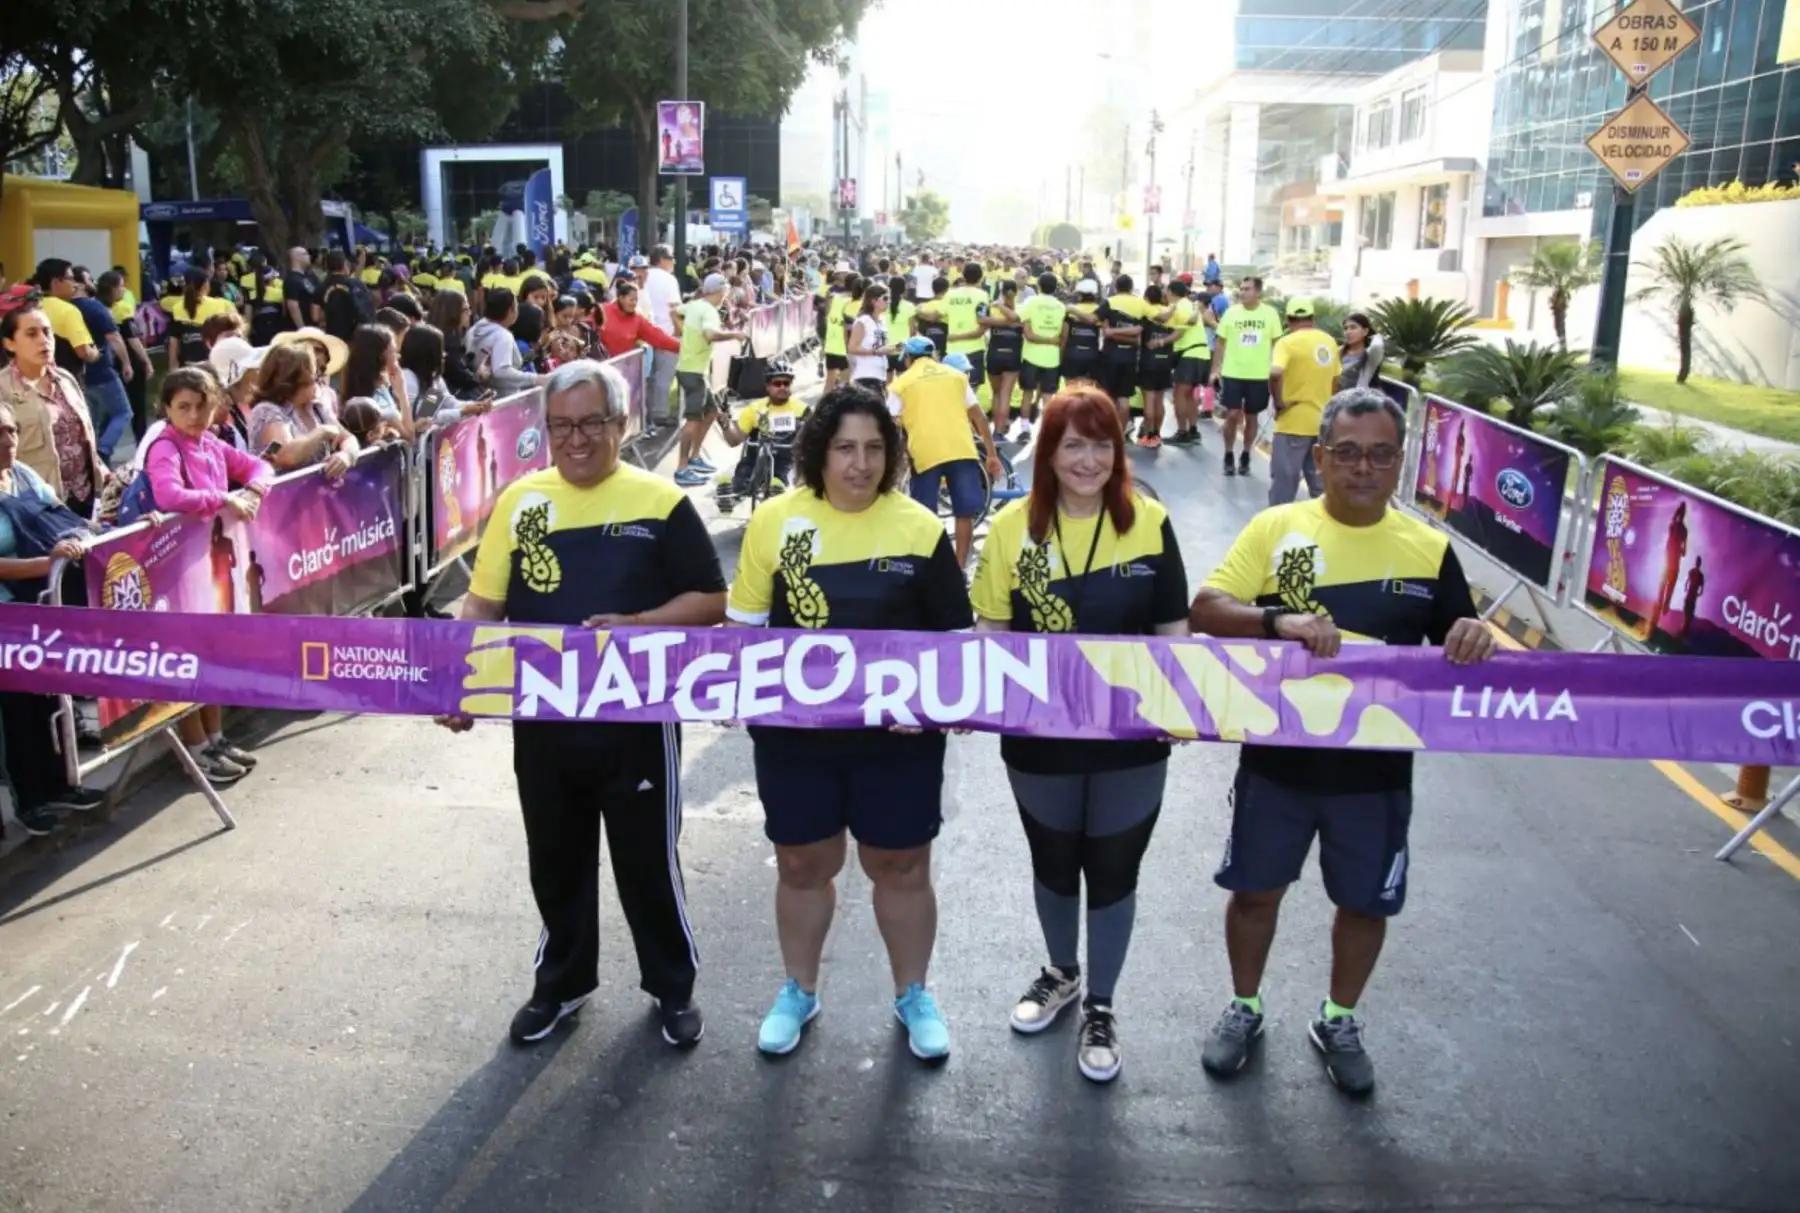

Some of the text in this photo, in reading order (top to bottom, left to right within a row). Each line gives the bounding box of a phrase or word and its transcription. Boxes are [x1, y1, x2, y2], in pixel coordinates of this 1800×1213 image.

[1618, 15, 1677, 29] OBRAS
[1610, 36, 1678, 51] A 150 M
[1607, 125, 1671, 139] DISMINUIR
[1602, 144, 1672, 158] VELOCIDAD
[531, 200, 550, 245] Ford
[1283, 544, 1319, 566] NAT
[1279, 572, 1315, 592] RUN
[333, 646, 408, 664] NATIONAL
[332, 662, 429, 682] GEOGRAPHIC
[859, 636, 1048, 726] RUN
[1451, 685, 1579, 721] LIMA
[1741, 700, 1800, 740] Cl
